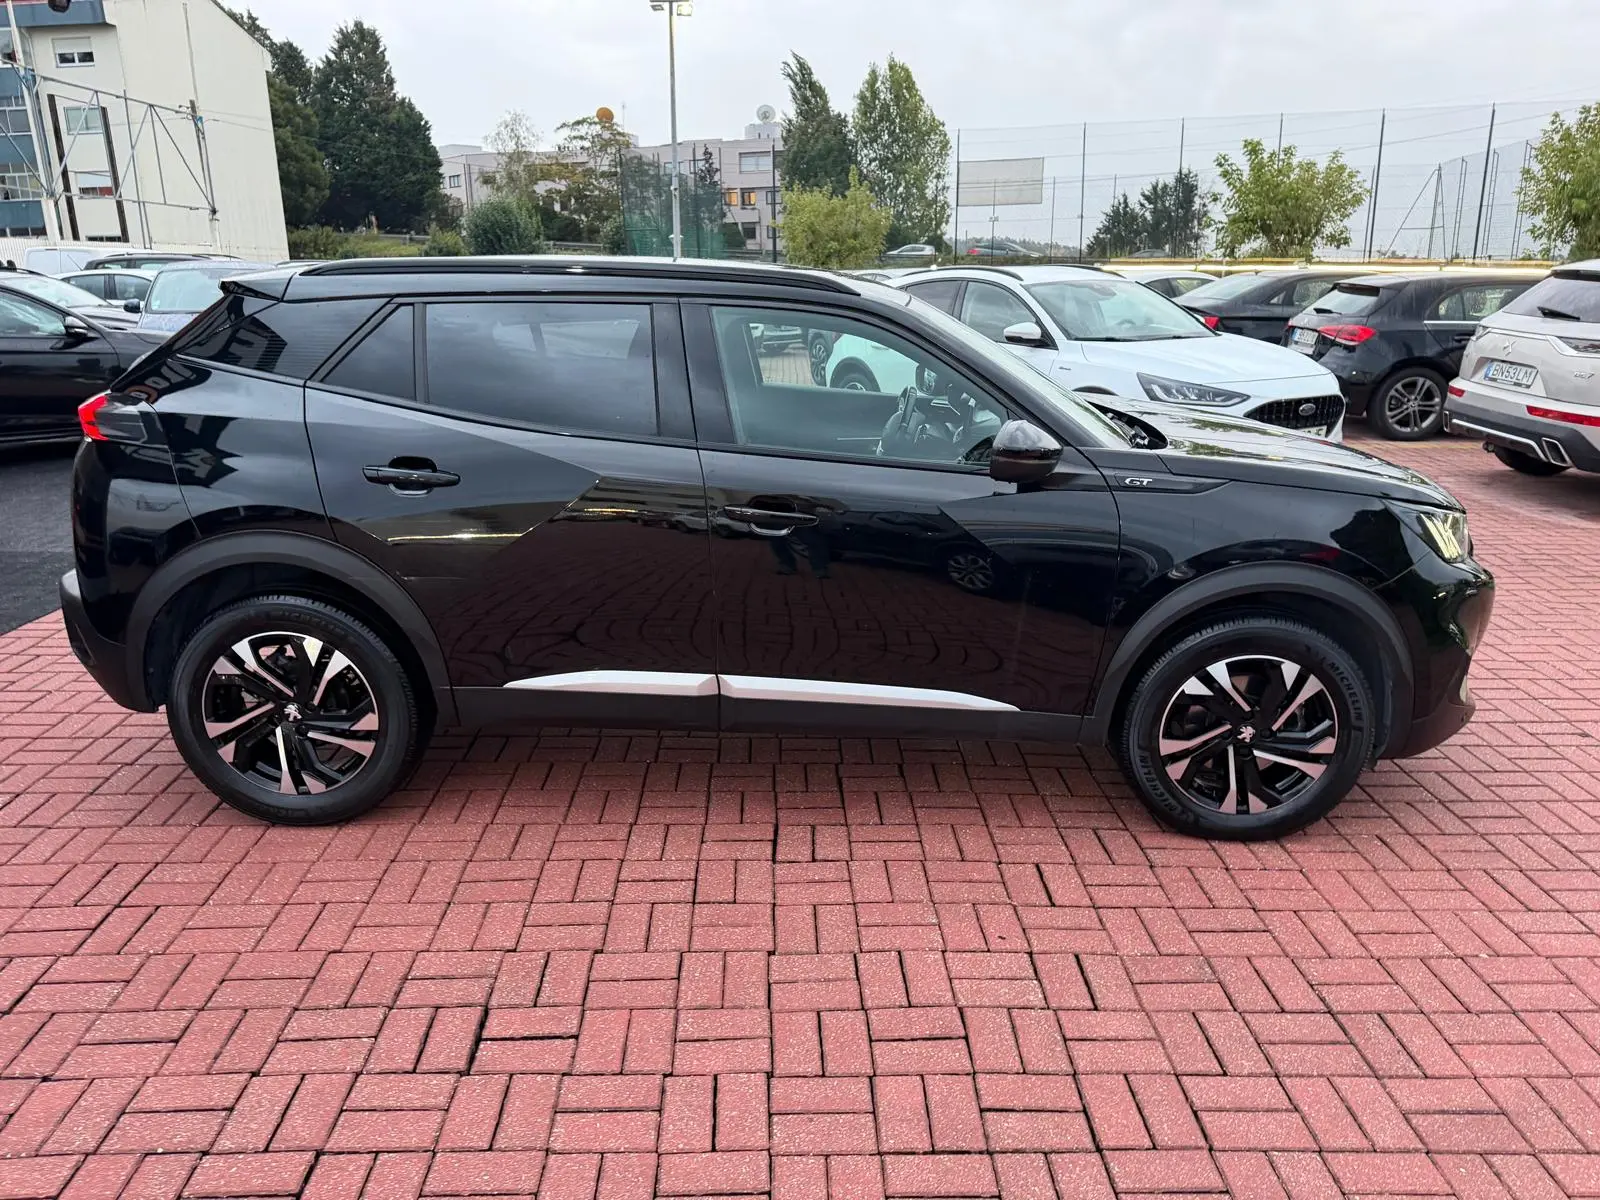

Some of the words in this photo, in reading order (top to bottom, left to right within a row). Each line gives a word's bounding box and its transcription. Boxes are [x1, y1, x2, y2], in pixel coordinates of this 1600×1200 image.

[1492, 364, 1533, 383] BN53LM
[1124, 477, 1153, 486] GT
[1328, 662, 1364, 722] MICHELIN
